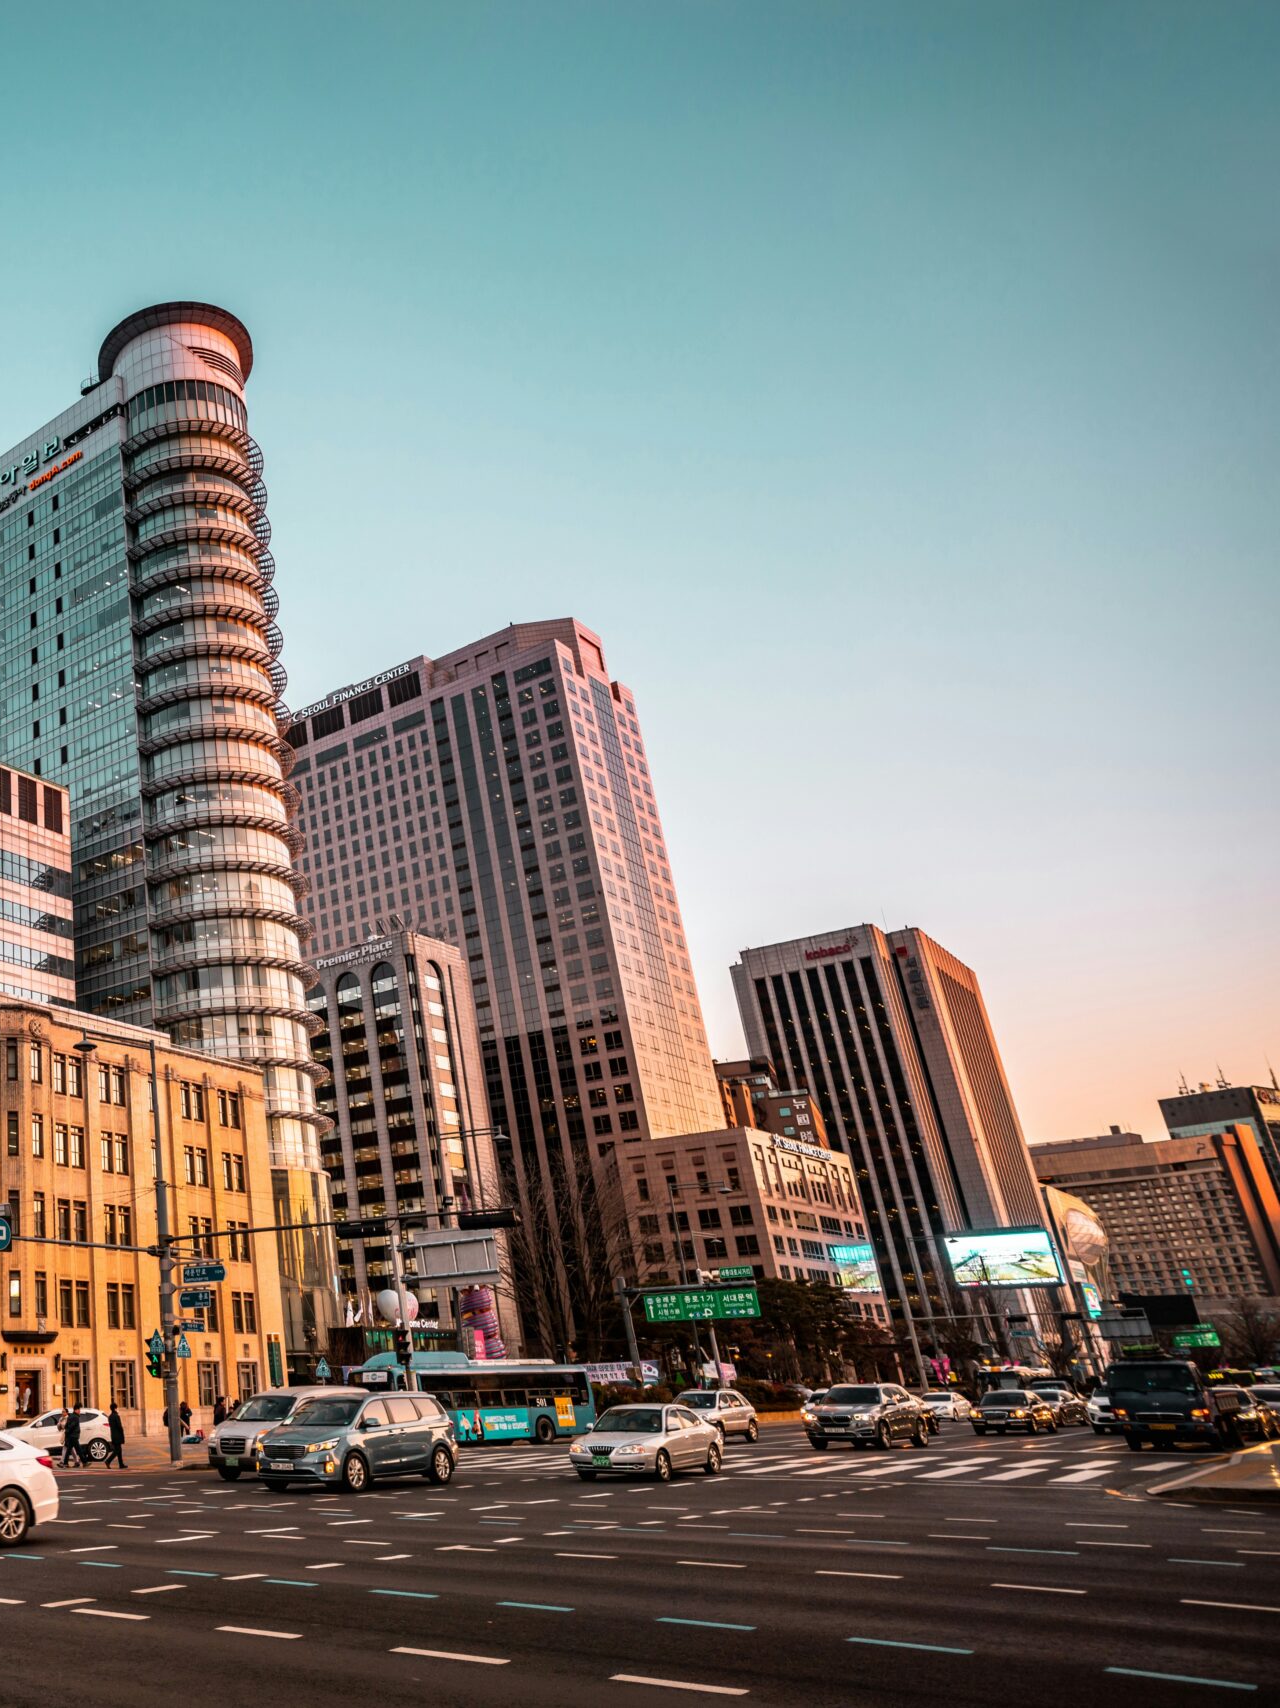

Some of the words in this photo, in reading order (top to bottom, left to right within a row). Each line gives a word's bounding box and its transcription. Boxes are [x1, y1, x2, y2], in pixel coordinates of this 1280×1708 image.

[28, 450, 82, 491] dongA.com
[302, 700, 331, 718] SEOUL
[333, 681, 373, 704] FINANCE
[374, 664, 410, 685] CENTER
[805, 944, 851, 960] kobaco
[655, 1295, 677, 1303] 숭례문
[722, 1293, 753, 1302] 서대문역
[536, 1398, 547, 1407] 501
